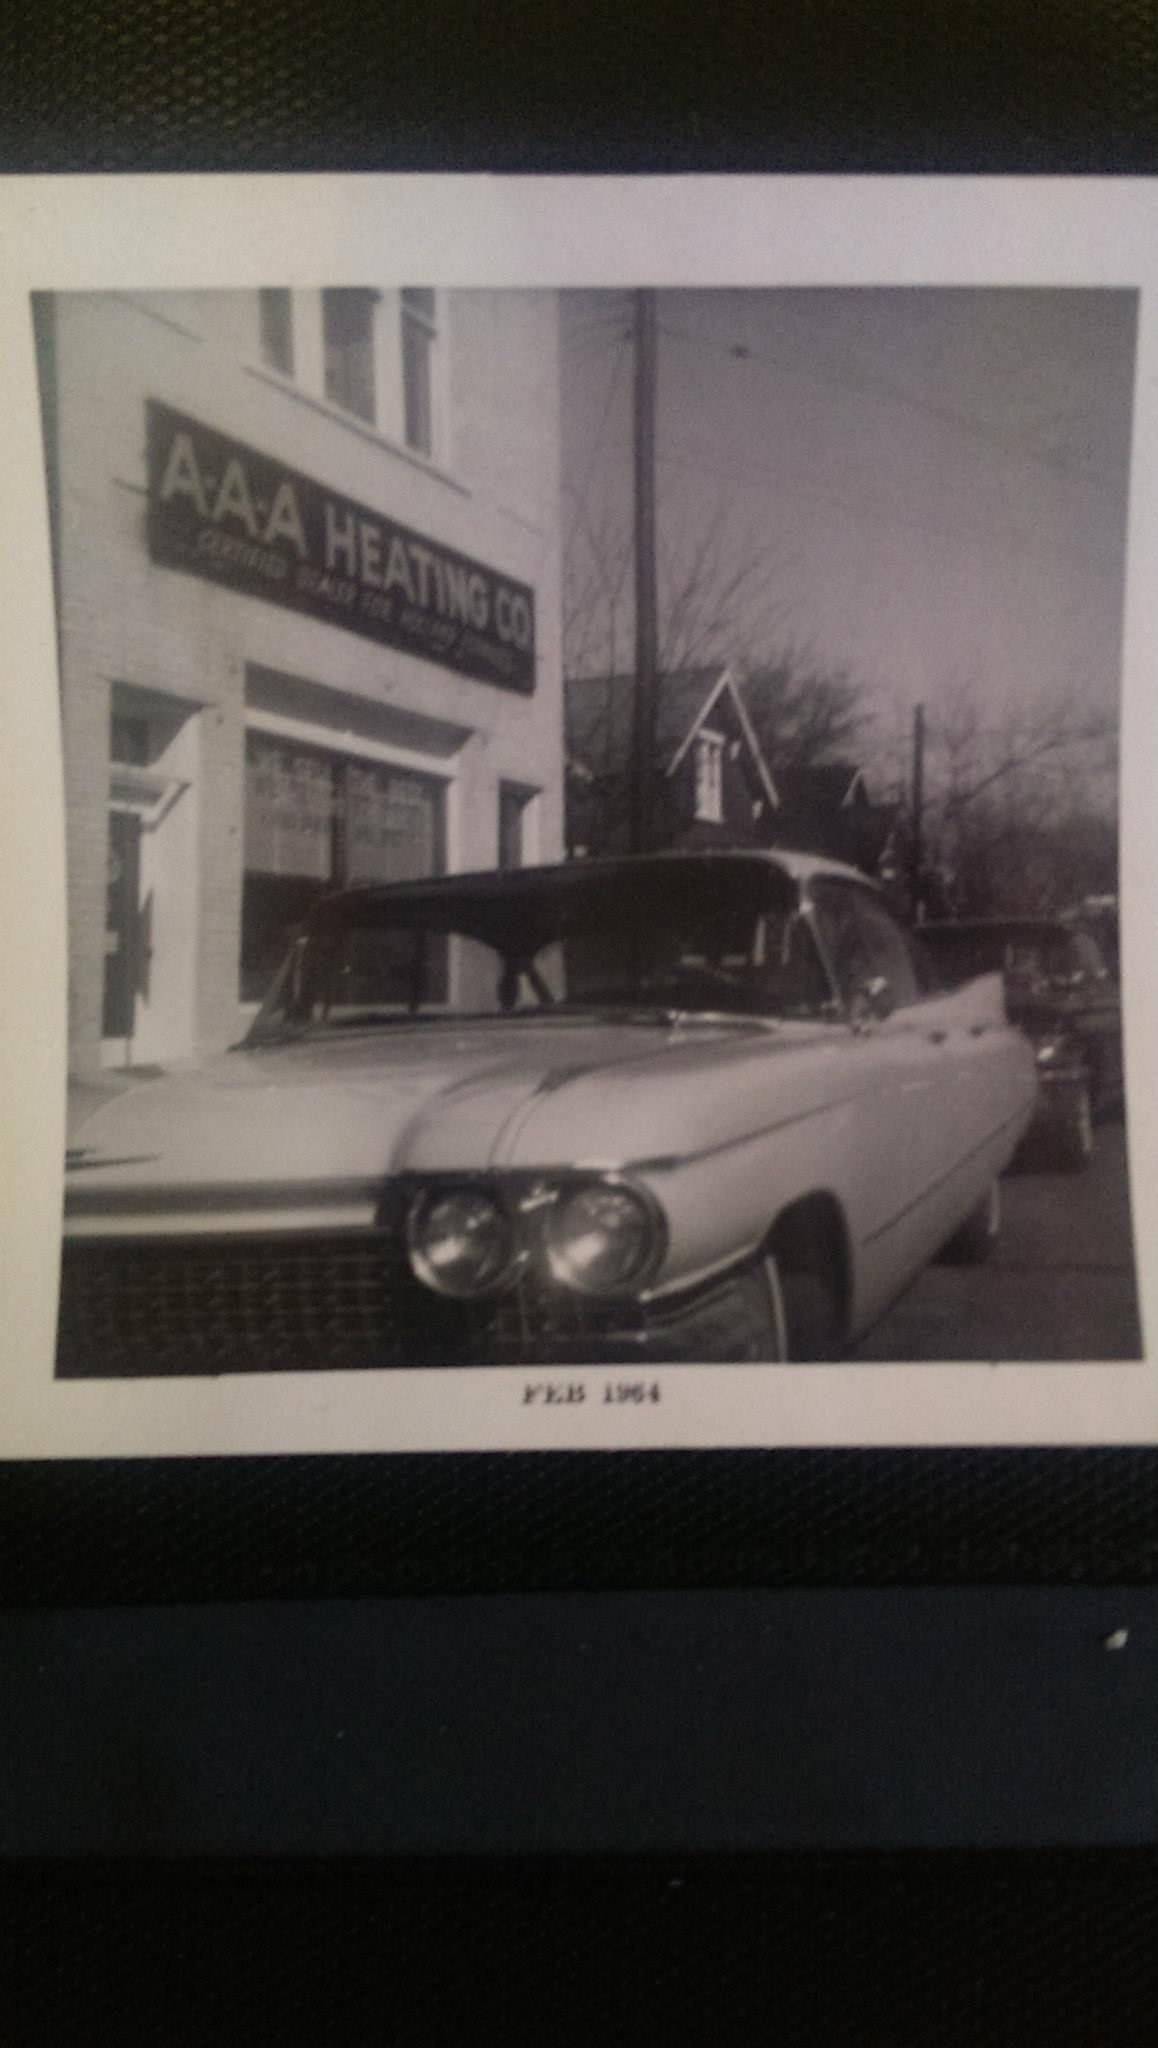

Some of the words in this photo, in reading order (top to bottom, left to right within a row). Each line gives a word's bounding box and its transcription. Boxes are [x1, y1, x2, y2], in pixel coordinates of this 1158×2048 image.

[325, 504, 488, 629] HEATING
[523, 1382, 586, 1405] FEB
[604, 1382, 660, 1405] 1964
